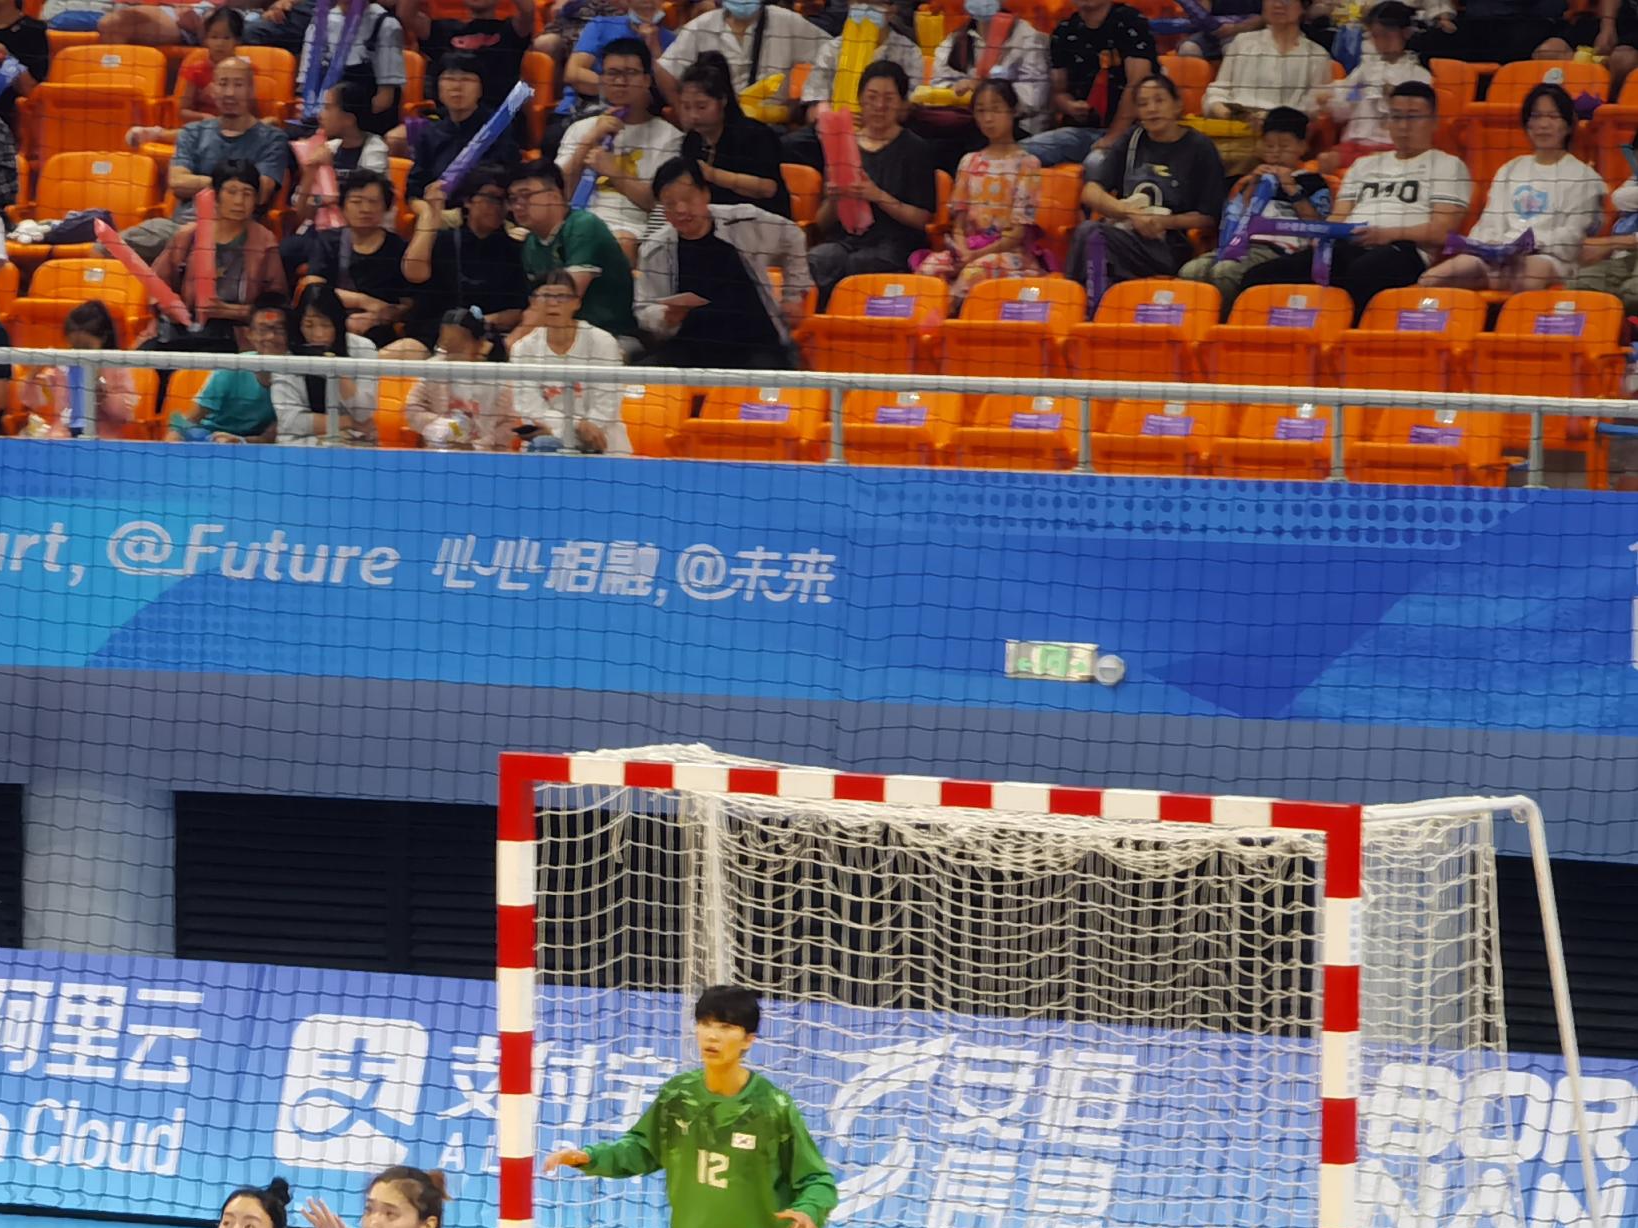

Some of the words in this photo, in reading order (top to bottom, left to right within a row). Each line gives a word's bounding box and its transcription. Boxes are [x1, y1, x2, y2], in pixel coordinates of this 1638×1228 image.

[105, 519, 402, 587] @Future
[21, 1097, 187, 1177] Cloud
[697, 1149, 730, 1190] 12
